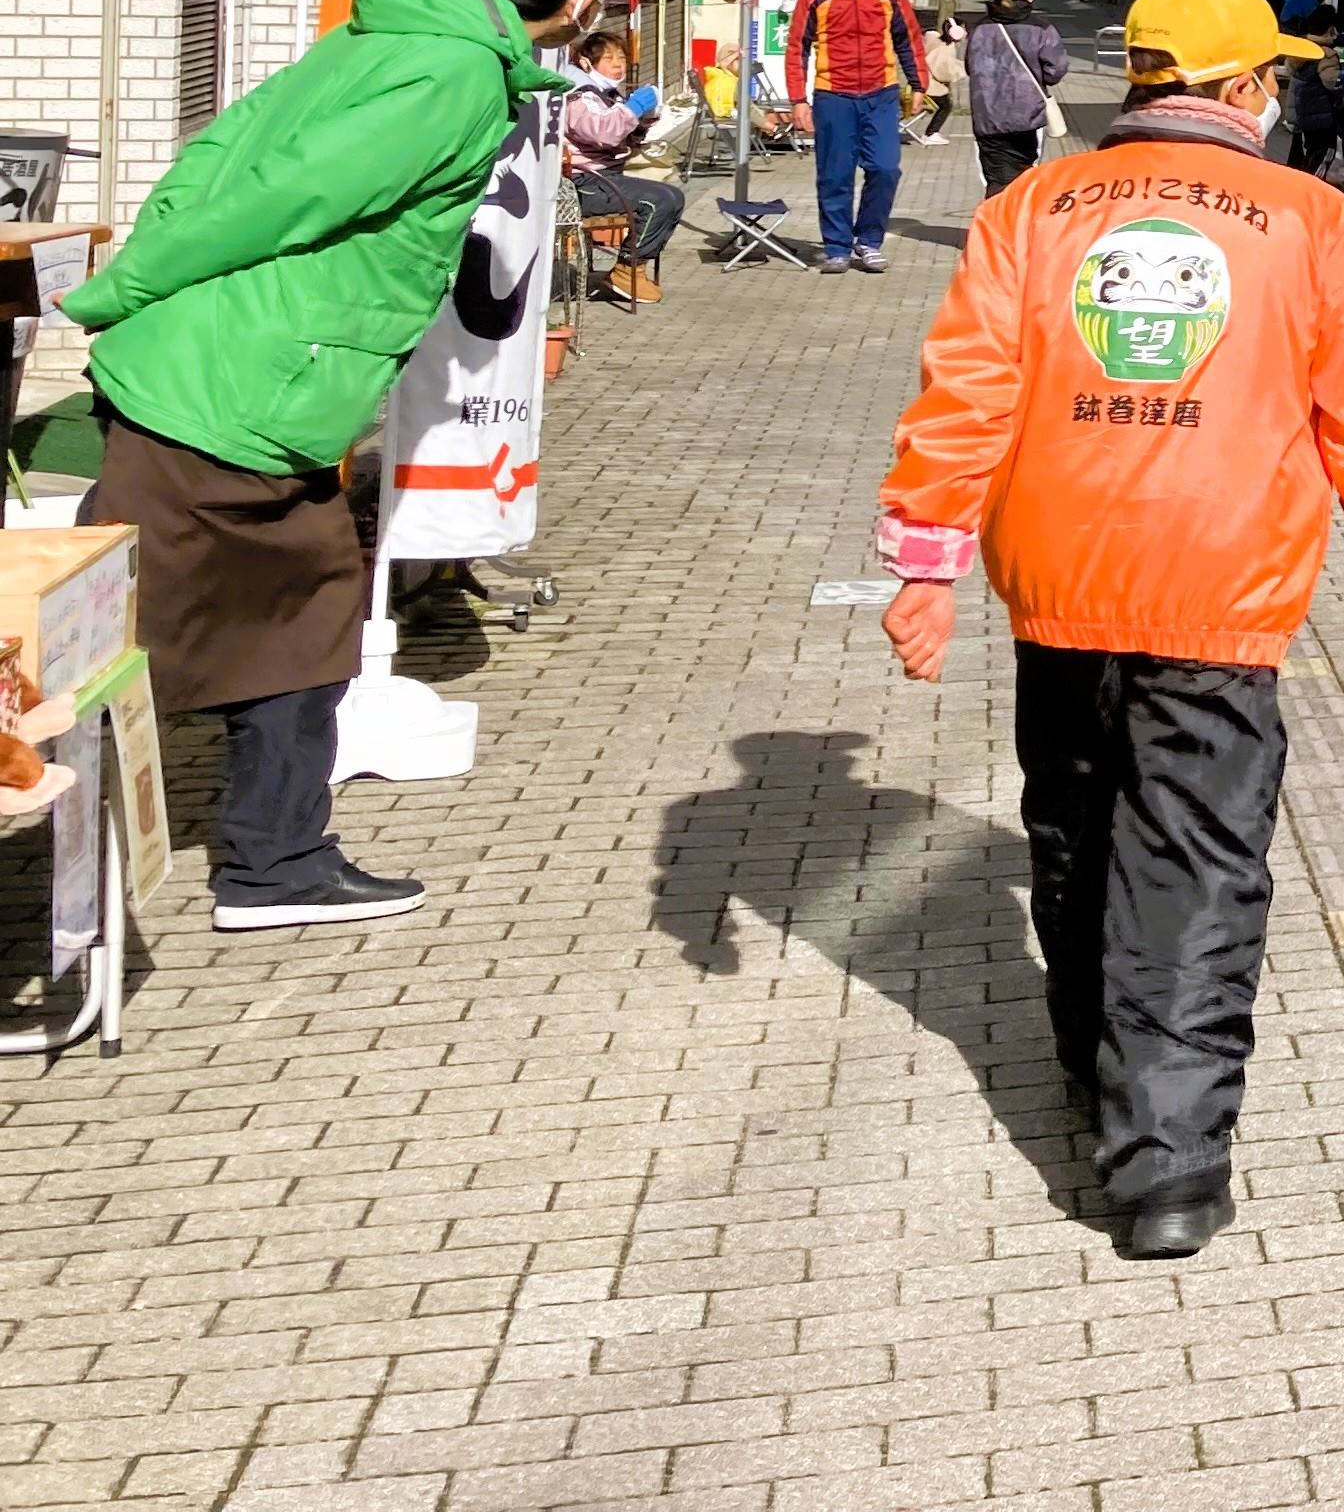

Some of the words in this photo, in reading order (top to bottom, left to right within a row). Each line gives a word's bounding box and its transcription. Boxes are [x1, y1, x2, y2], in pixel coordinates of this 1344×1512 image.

[1118, 317, 1177, 366] 望
[1072, 391, 1203, 428] 鉢巻達磨
